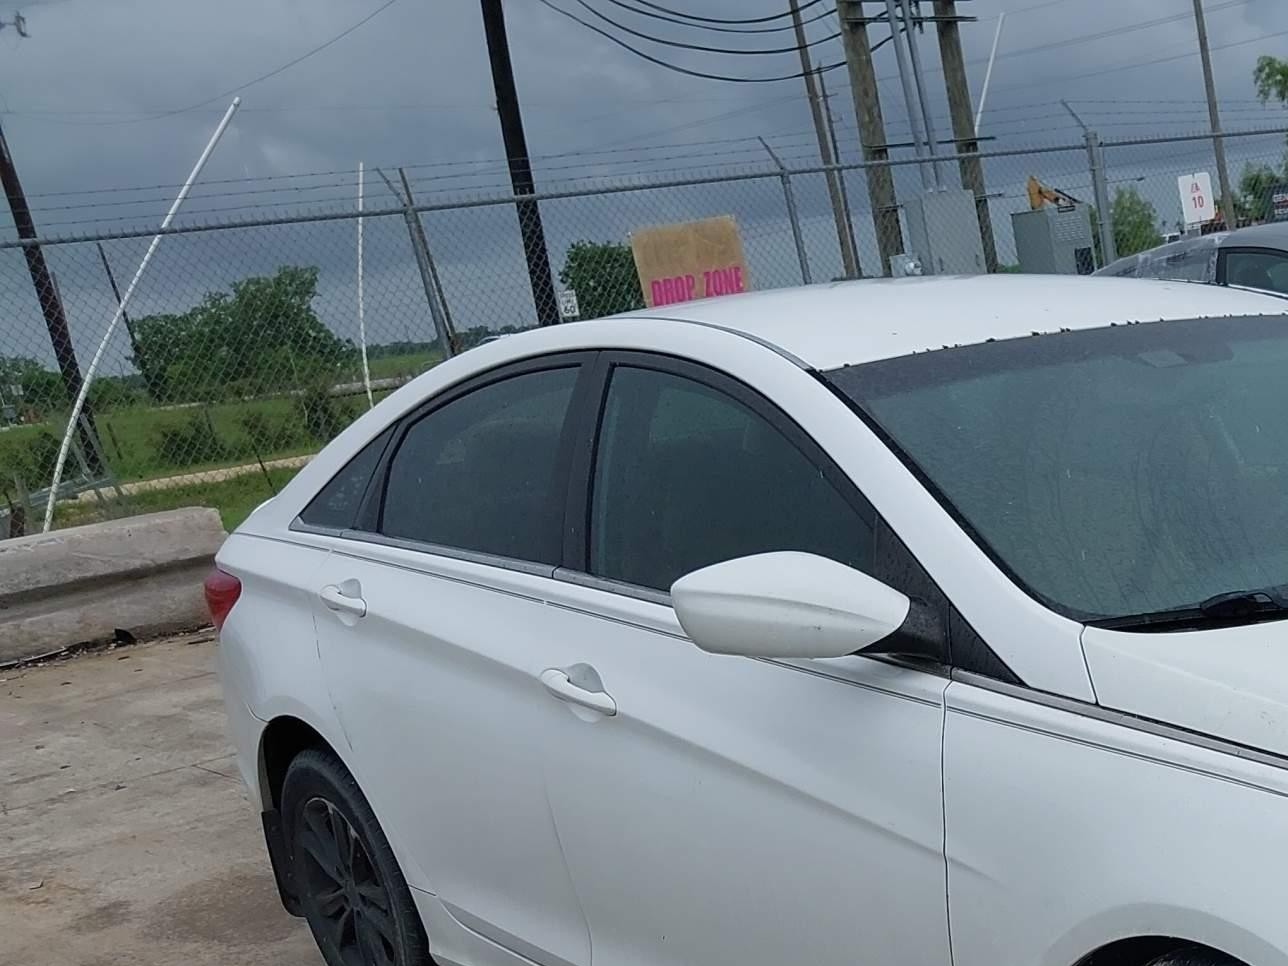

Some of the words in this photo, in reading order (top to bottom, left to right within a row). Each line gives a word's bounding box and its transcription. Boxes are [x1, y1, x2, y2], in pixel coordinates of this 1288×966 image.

[1192, 195, 1204, 208] 10
[651, 274, 695, 306] DROP
[704, 266, 744, 297] ZONE
